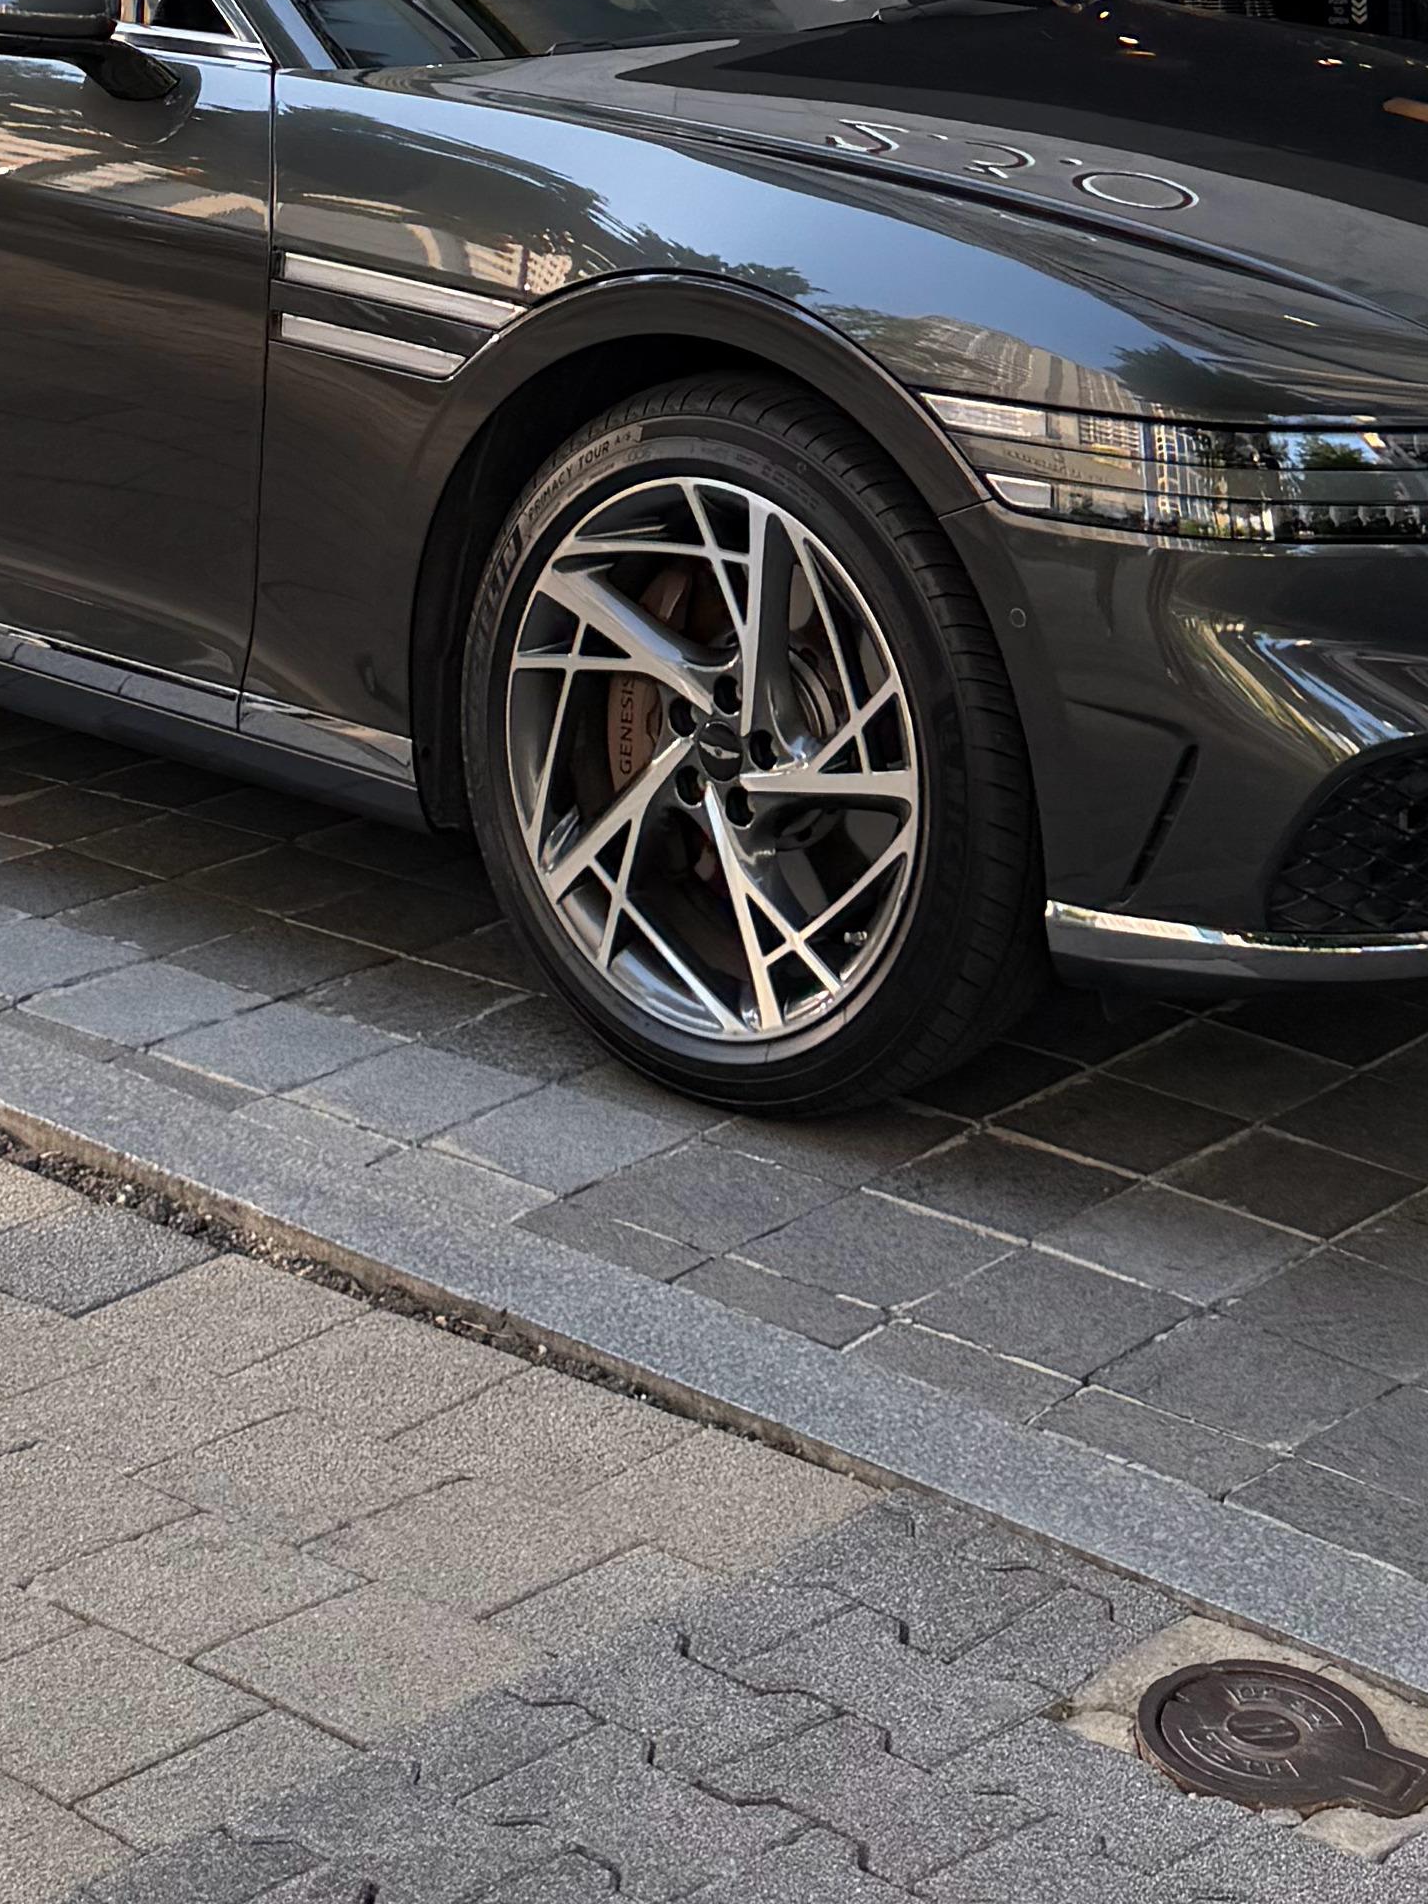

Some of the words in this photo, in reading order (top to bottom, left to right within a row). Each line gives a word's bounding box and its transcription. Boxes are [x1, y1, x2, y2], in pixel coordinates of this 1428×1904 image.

[527, 465, 573, 523] PRIMACY
[578, 440, 610, 472] TOUR
[619, 678, 635, 775] GENESIS
